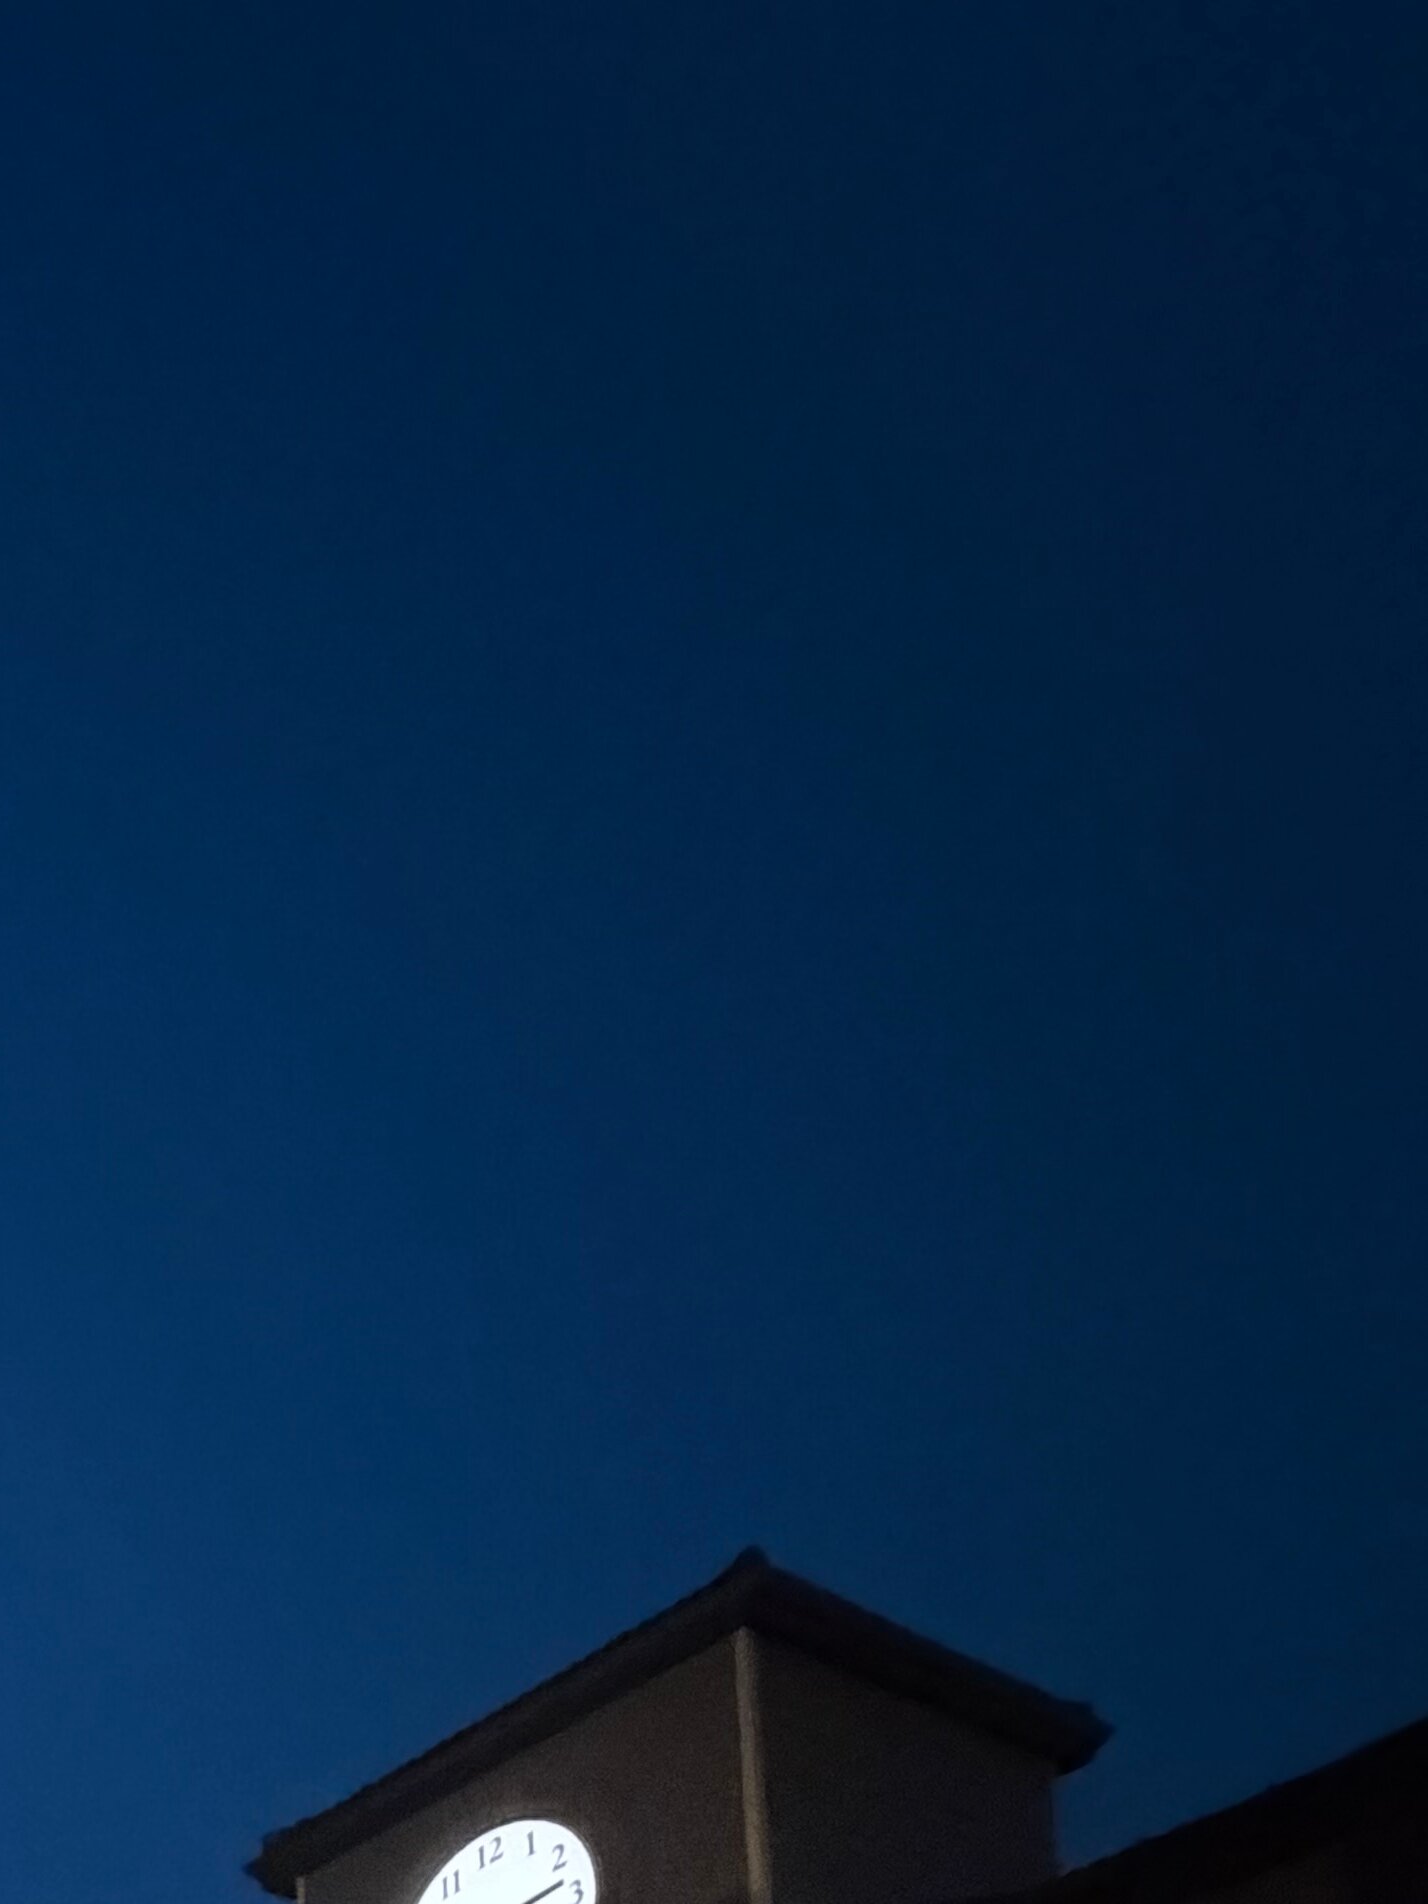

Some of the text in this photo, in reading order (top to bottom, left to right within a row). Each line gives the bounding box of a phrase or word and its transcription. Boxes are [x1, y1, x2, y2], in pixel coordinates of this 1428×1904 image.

[478, 1836, 504, 1869] 12
[525, 1830, 536, 1855] 1
[552, 1843, 568, 1872] 2
[441, 1869, 461, 1900] 11
